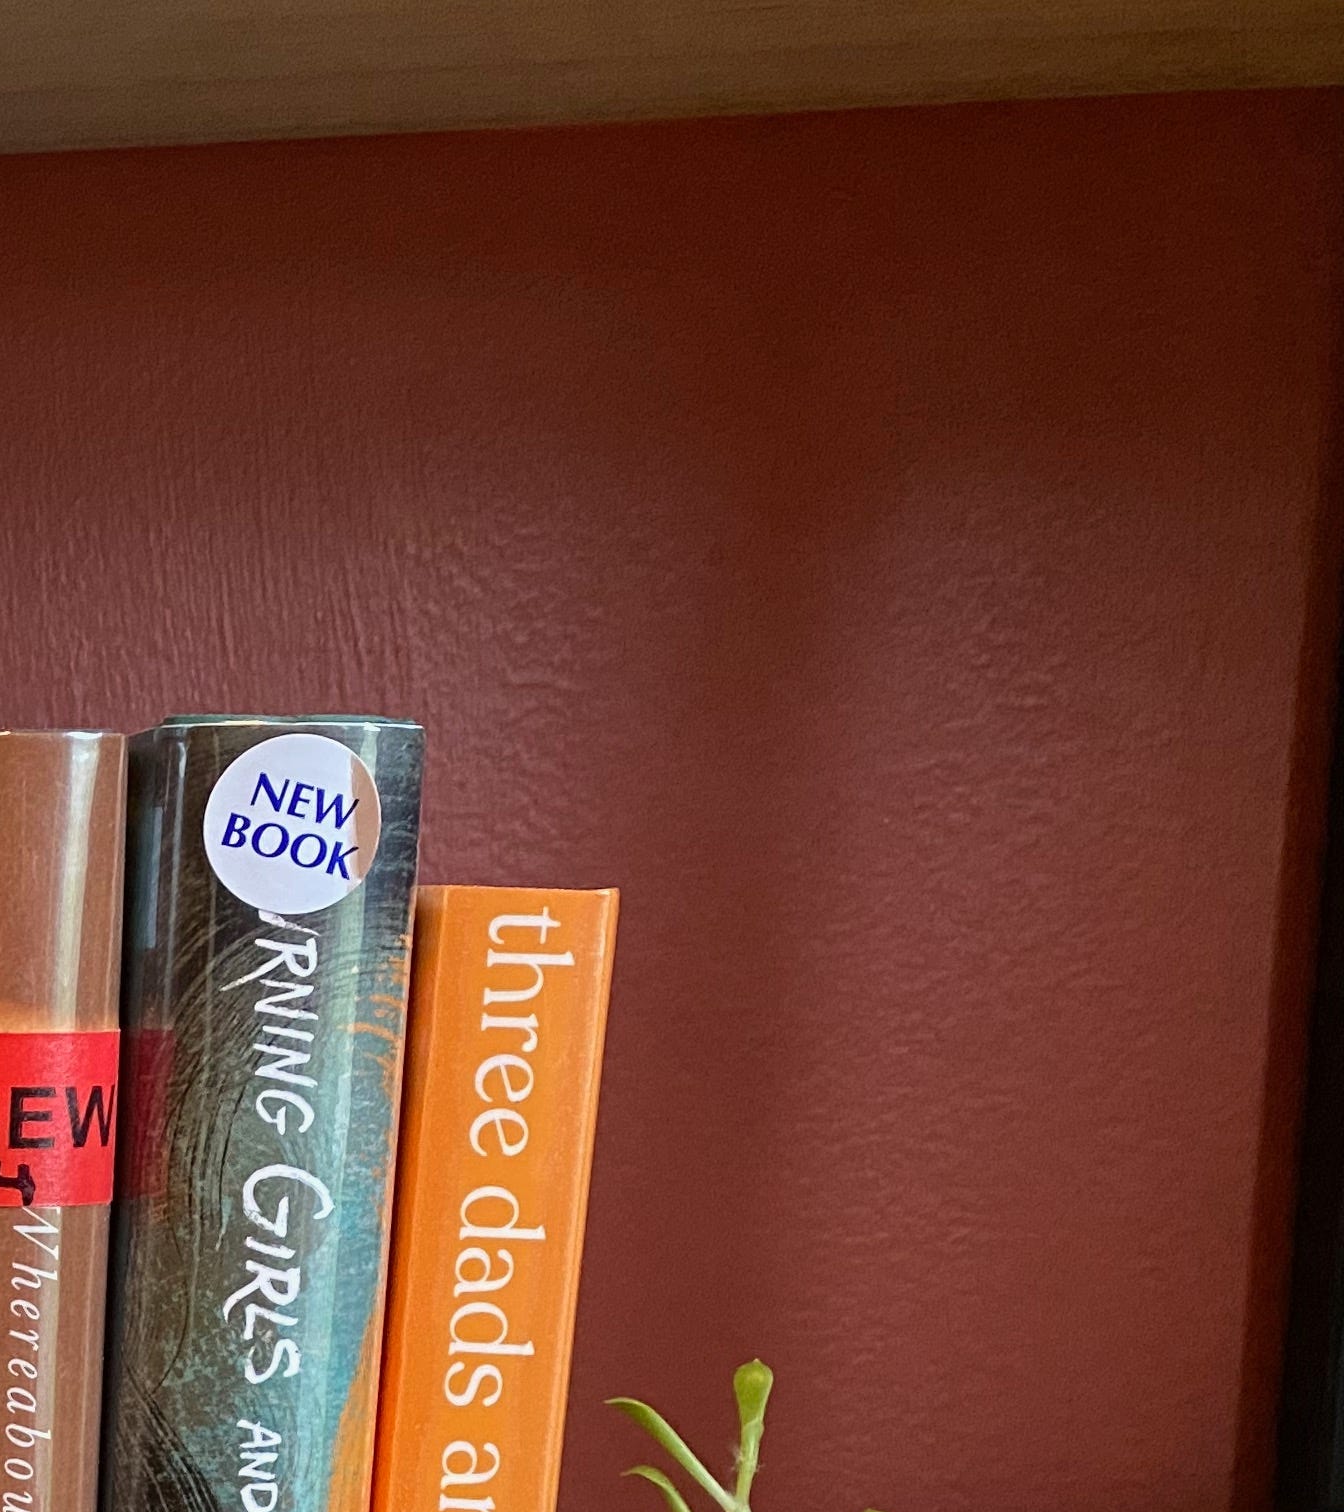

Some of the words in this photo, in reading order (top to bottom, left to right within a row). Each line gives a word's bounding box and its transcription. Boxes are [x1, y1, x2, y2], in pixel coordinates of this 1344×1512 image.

[220, 811, 360, 881] BOOK
[249, 771, 361, 830] NEW
[218, 909, 320, 1136] RNING
[468, 905, 576, 1158] three
[222, 1162, 335, 1386] GIRLS
[443, 1184, 547, 1408] dads
